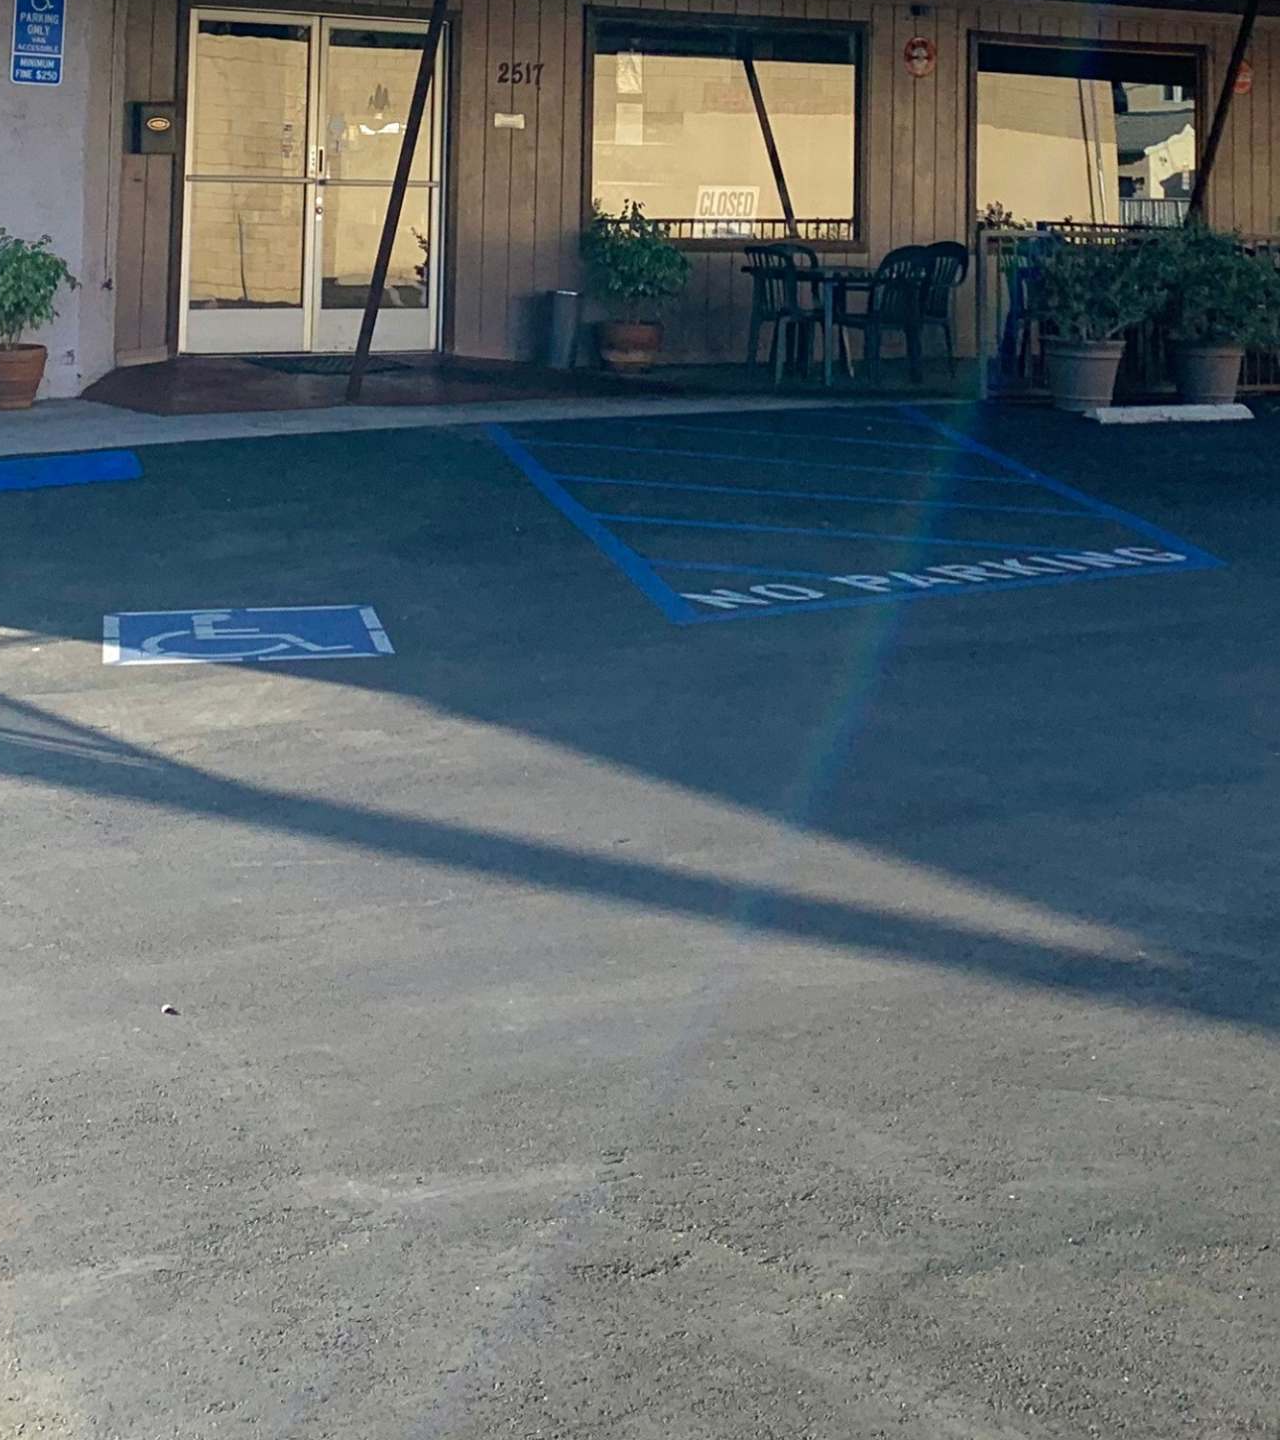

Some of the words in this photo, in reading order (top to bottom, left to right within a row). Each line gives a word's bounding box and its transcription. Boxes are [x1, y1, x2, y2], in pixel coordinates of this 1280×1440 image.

[20, 12, 59, 25] PARKING
[27, 24, 50, 36] ONLY
[20, 58, 55, 68] MINIMUM
[15, 69, 32, 79] FINE
[497, 62, 545, 86] 2517
[699, 191, 754, 216] CLOSED
[680, 584, 824, 609] NO
[829, 547, 1188, 591] PARKING
